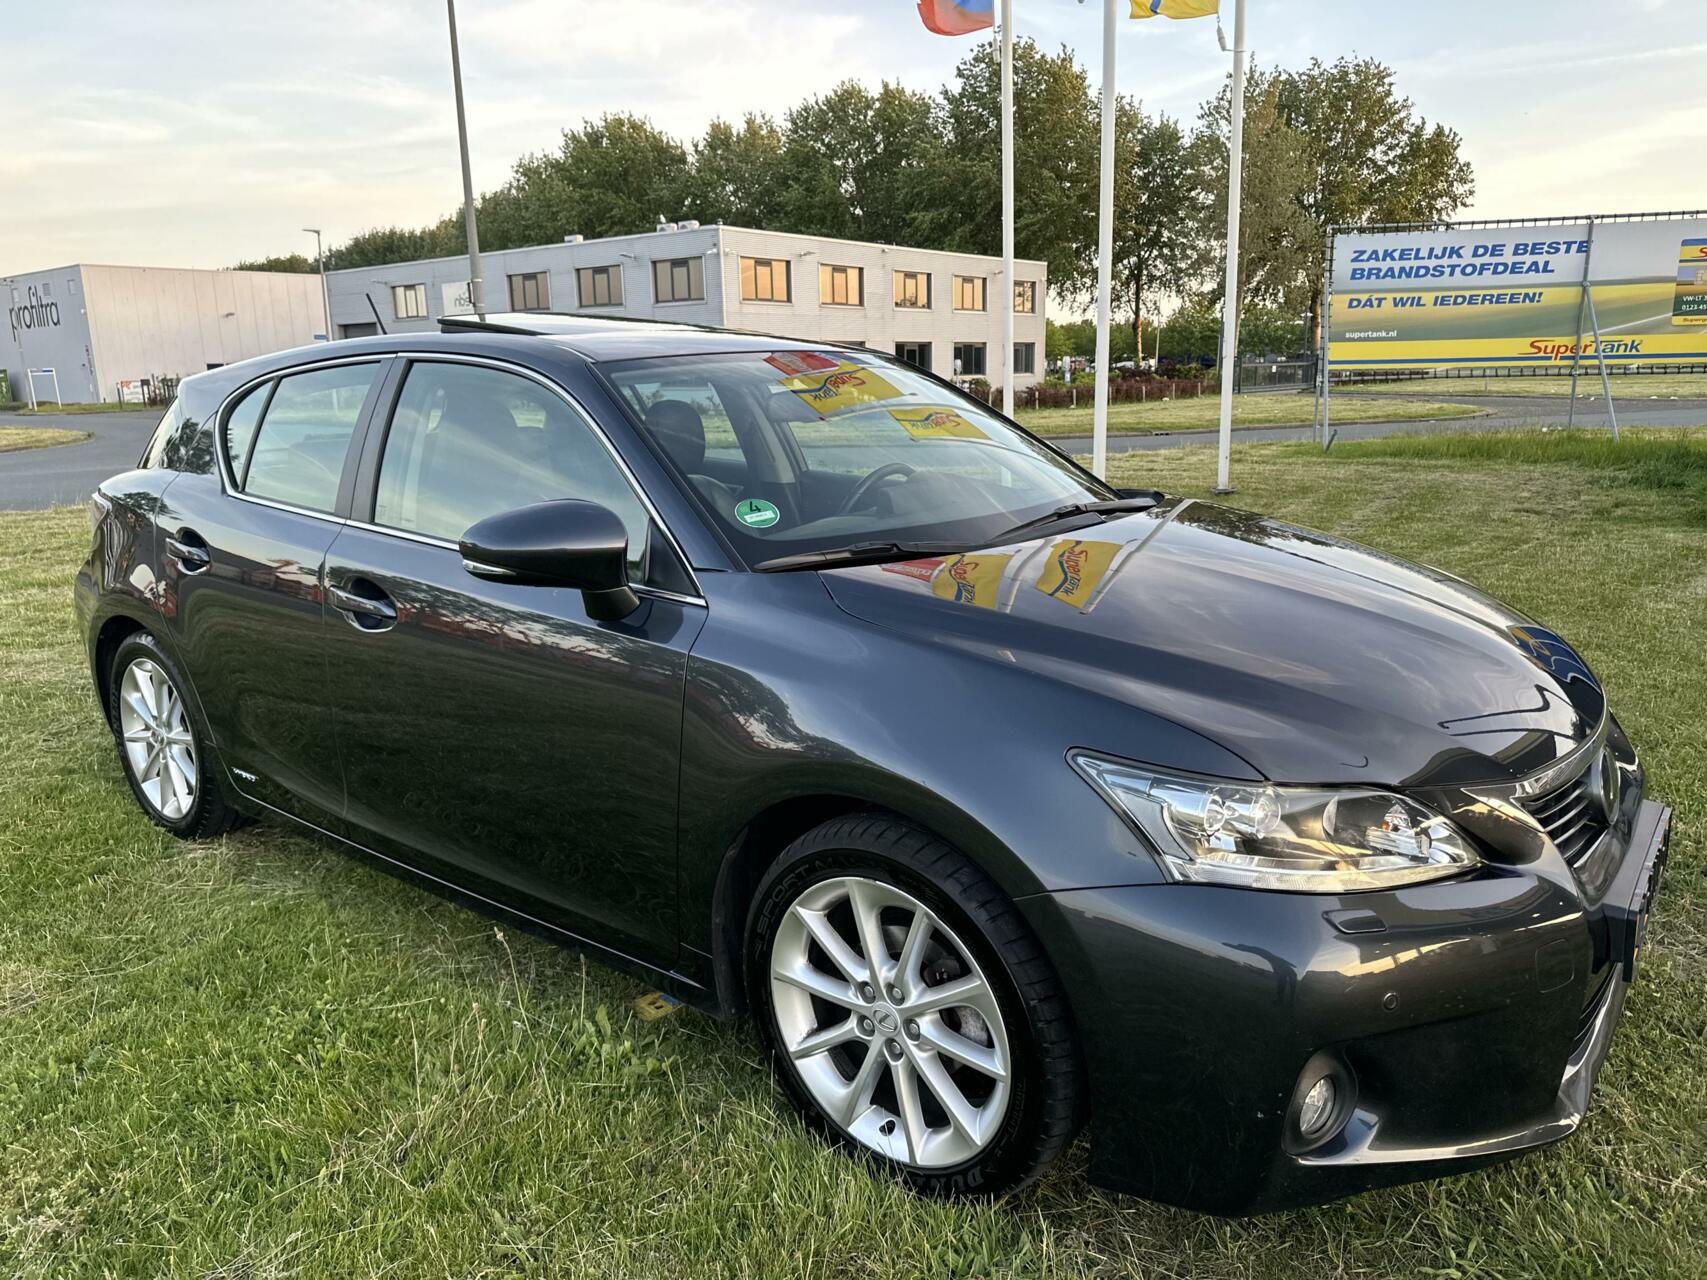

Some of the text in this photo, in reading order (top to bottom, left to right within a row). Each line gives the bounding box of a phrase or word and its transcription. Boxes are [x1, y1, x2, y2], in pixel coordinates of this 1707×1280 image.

[1350, 240, 1593, 263] ZAKELIJK DE BESTE
[1350, 260, 1555, 281] BRANDSTOFDEAL
[1347, 292, 1543, 309] DÁT WIL IEDEREEN!
[9, 285, 61, 342] profiltra
[1345, 330, 1397, 340] supertank.nl
[749, 500, 761, 512] 4
